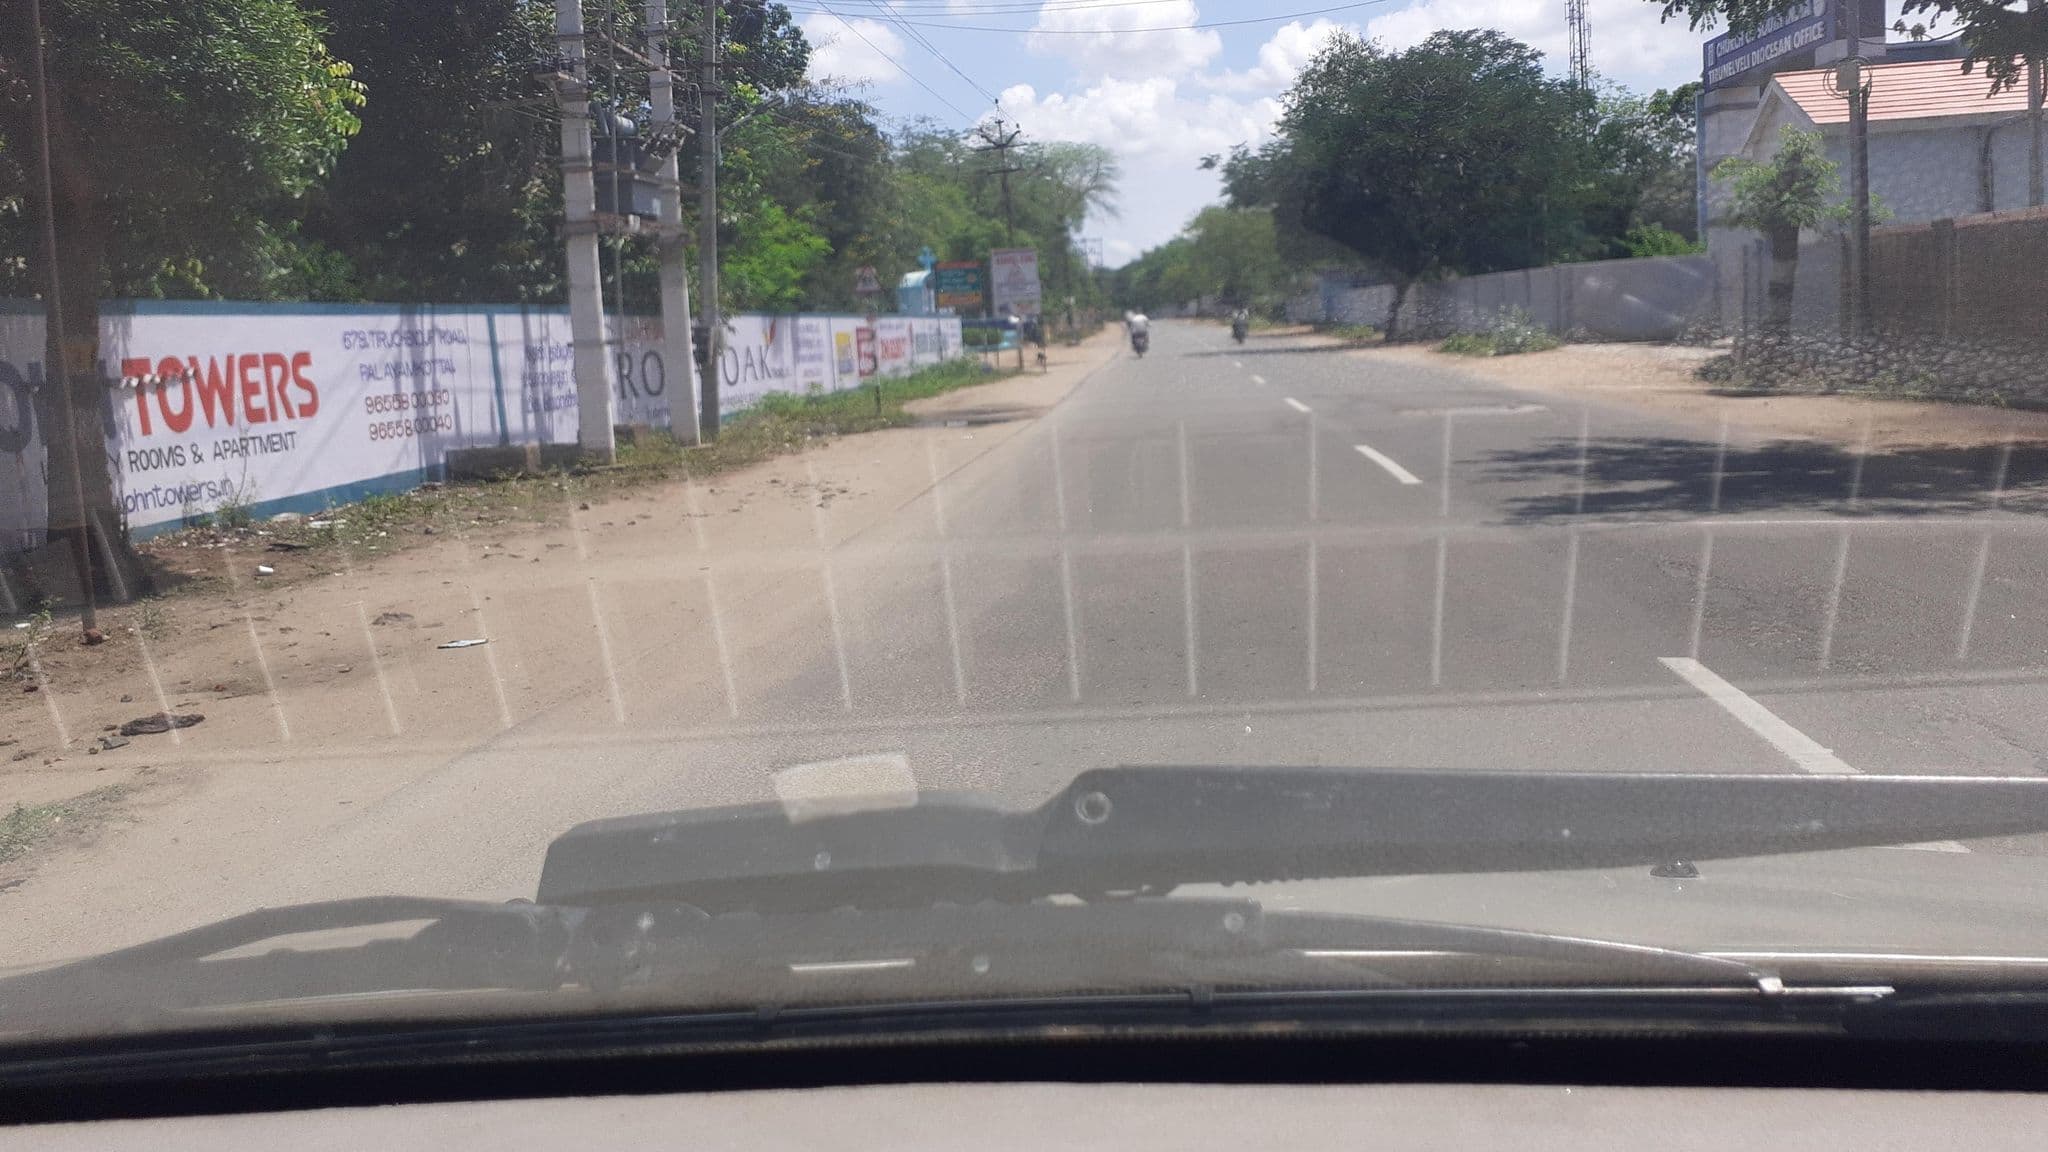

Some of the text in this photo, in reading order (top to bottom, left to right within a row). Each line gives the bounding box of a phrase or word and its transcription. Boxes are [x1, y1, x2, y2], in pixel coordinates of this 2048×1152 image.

[1793, 20, 1826, 49] OFFICE
[121, 351, 320, 437] TOWERS
[128, 445, 186, 473] ROOMS
[192, 441, 205, 464] &
[213, 431, 297, 461] APARTMENT
